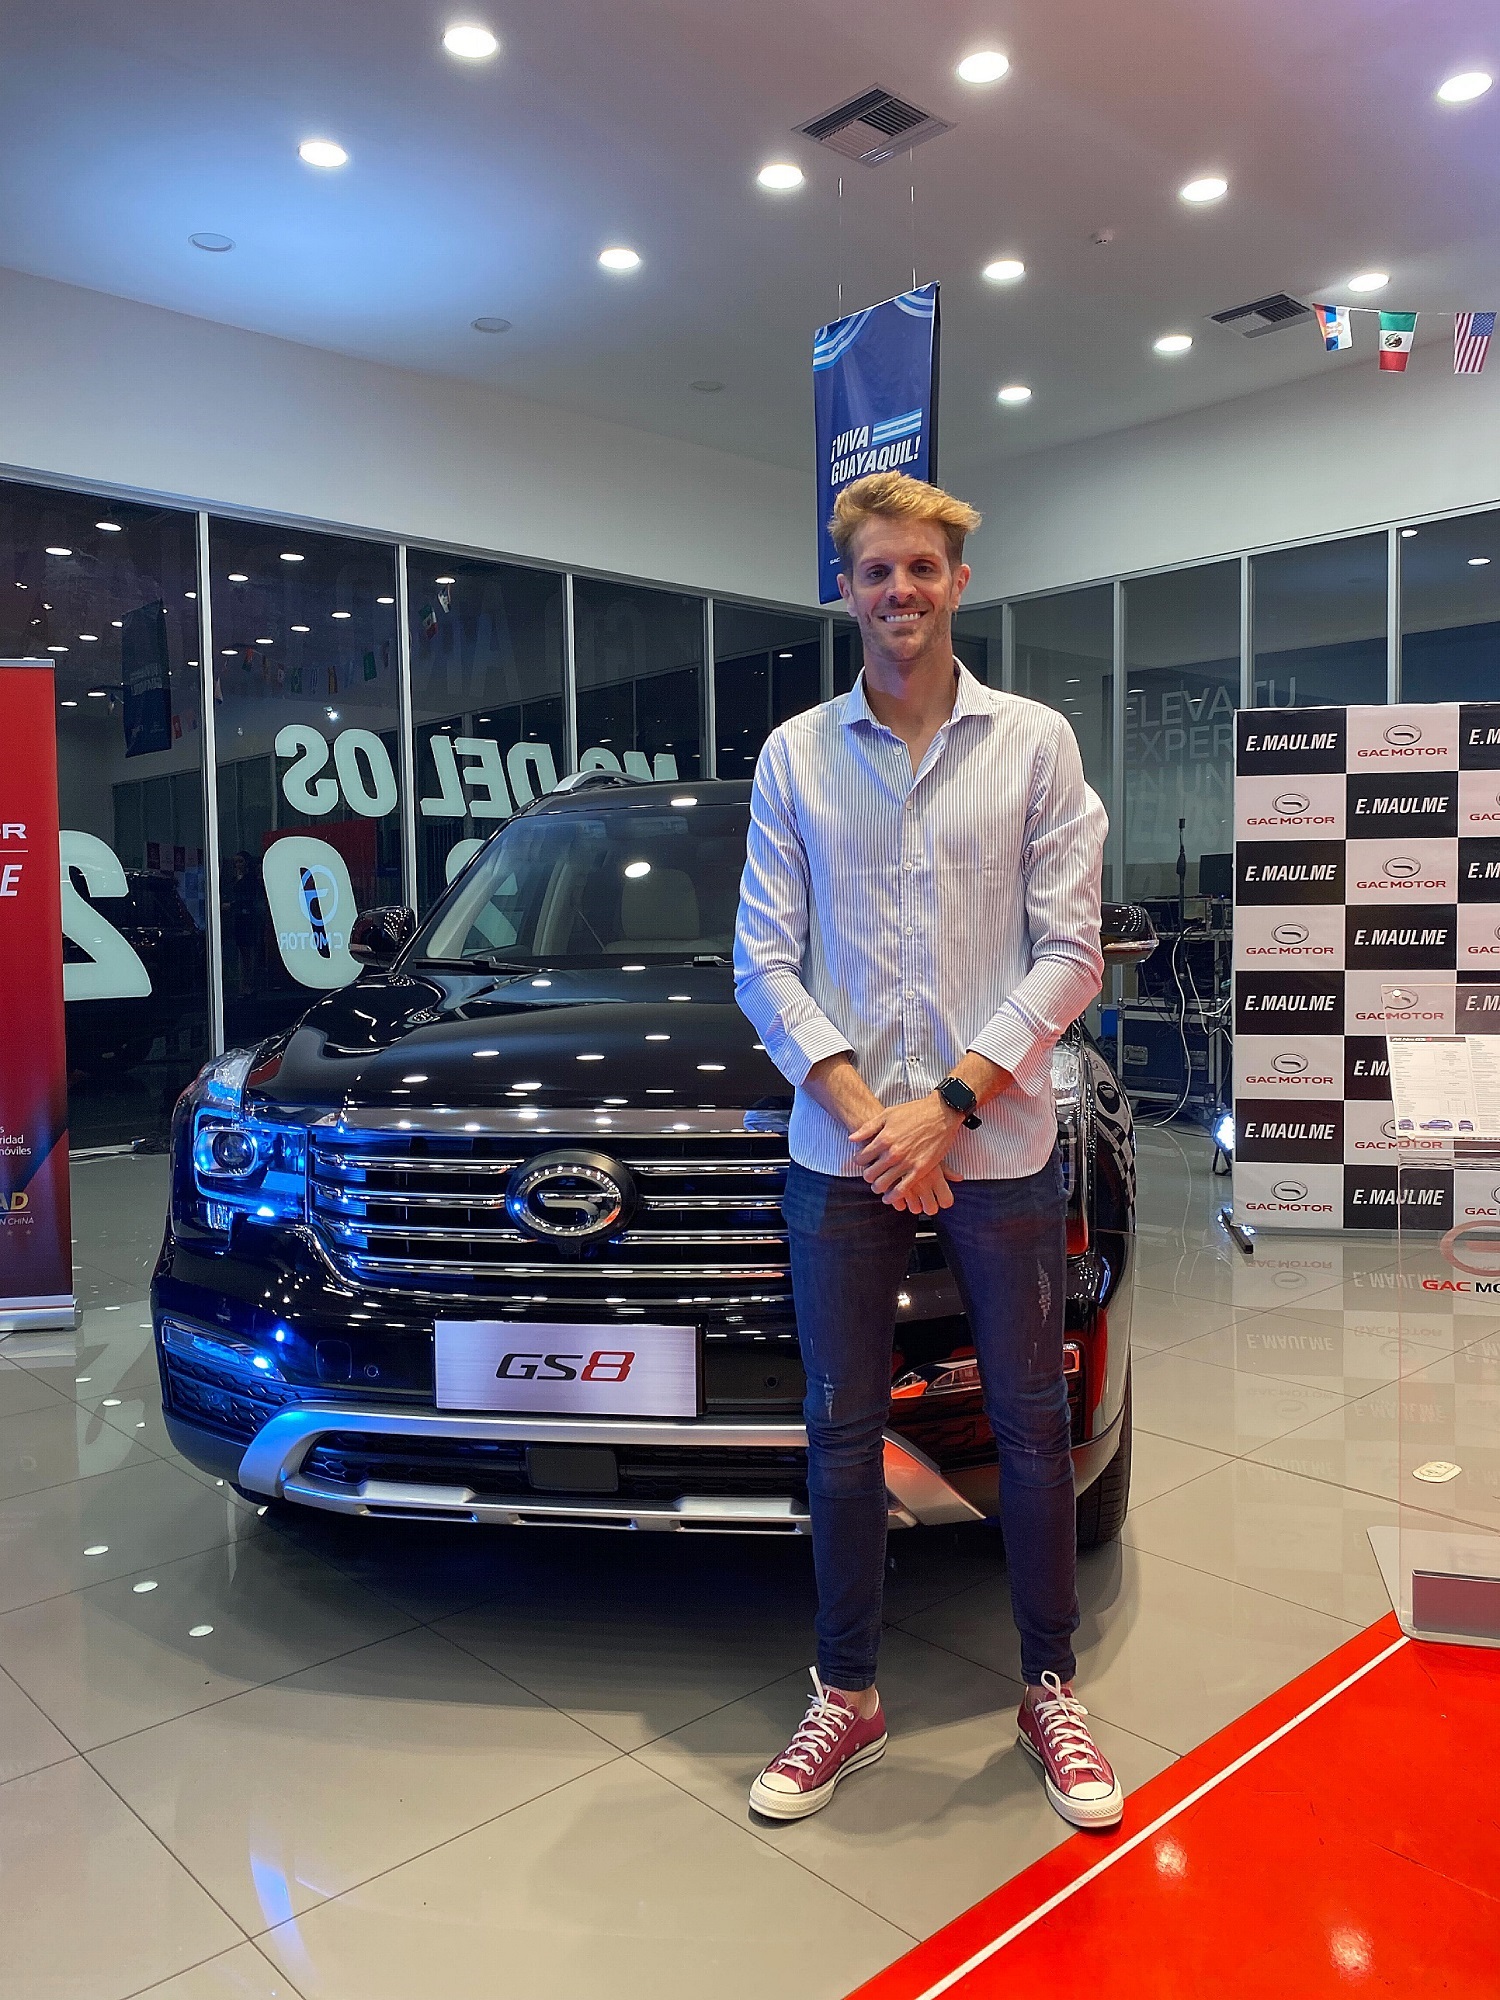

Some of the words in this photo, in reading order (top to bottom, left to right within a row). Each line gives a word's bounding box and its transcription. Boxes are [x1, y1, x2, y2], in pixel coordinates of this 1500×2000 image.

[830, 425, 870, 462] ¡VIVA
[830, 435, 921, 486] GUAYAQUIL!
[1246, 733, 1337, 751] E.MAULME
[1357, 749, 1388, 757] GAC
[1391, 748, 1448, 756] MOTOR
[1355, 797, 1449, 815] E.MAULME
[1246, 817, 1277, 825] GAC
[1280, 816, 1335, 825] MOTOR
[0, 823, 27, 839] R
[1245, 865, 1337, 882] E.MAULME
[1356, 881, 1388, 889] GAC
[1390, 880, 1446, 889] MOTOR
[1354, 929, 1448, 946] E.MAULME
[1246, 947, 1277, 955] GAC
[1279, 947, 1334, 955] MOTOR
[1245, 995, 1336, 1011] E.MAULME
[1465, 995, 1500, 1011] E.M
[1386, 1012, 1445, 1020] MOTOR
[1354, 1060, 1390, 1076] E.M
[1246, 1076, 1276, 1084] GAC
[1245, 1122, 1336, 1140] E.MAULME
[1355, 1141, 1386, 1149] GAC
[1353, 1189, 1445, 1206] E.MAULME
[1246, 1203, 1276, 1211] GAC
[1279, 1203, 1333, 1212] MOTOR
[7, 1217, 34, 1226] CHINA
[1422, 1279, 1472, 1292] GAC
[495, 1350, 636, 1383] GS8
